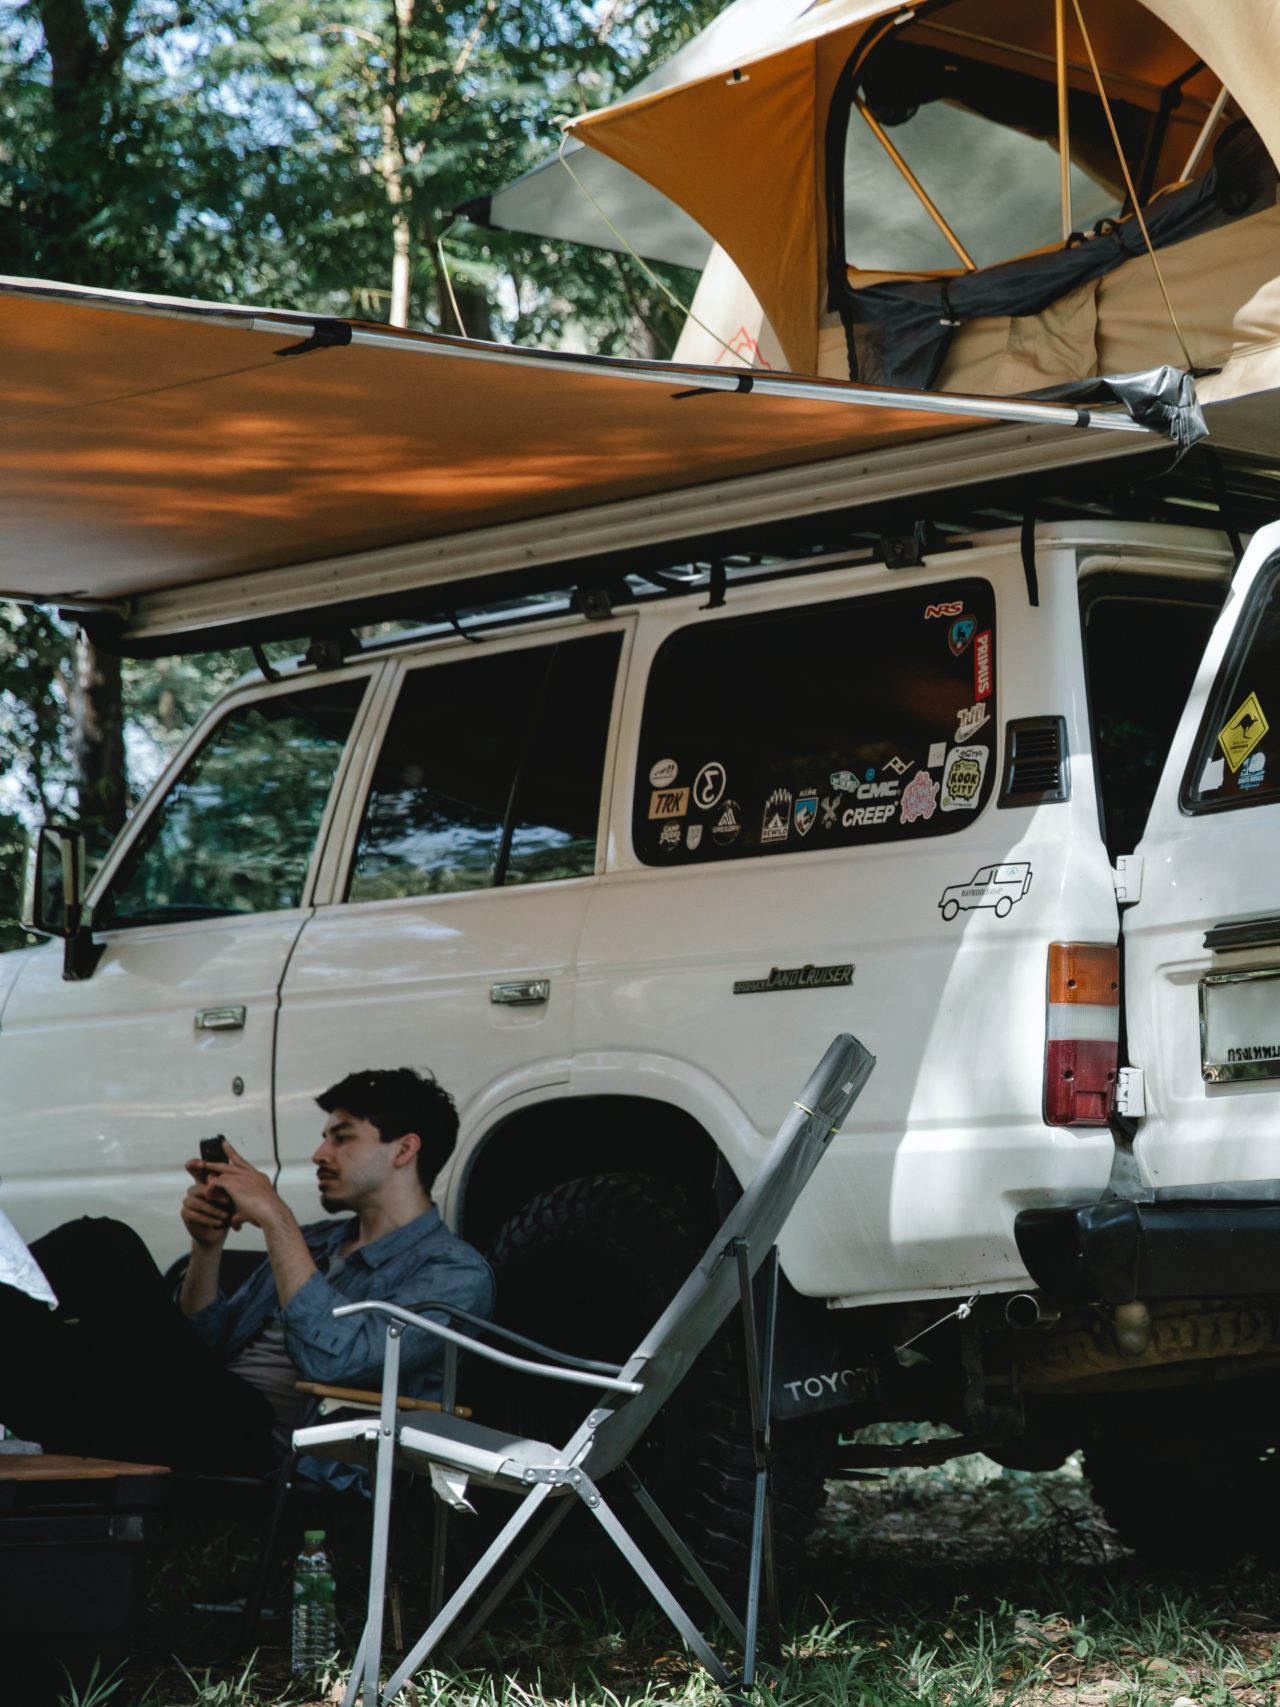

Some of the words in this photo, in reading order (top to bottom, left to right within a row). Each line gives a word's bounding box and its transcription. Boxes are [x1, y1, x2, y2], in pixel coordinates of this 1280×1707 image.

[925, 602, 963, 619] NRS
[977, 634, 990, 694] PRIMUS
[950, 773, 978, 785] KOOK
[857, 781, 899, 800] CMC
[952, 785, 973, 795] CITY
[655, 792, 684, 815] TRK
[842, 804, 896, 828] CREEP
[783, 1367, 880, 1402] TOYO
